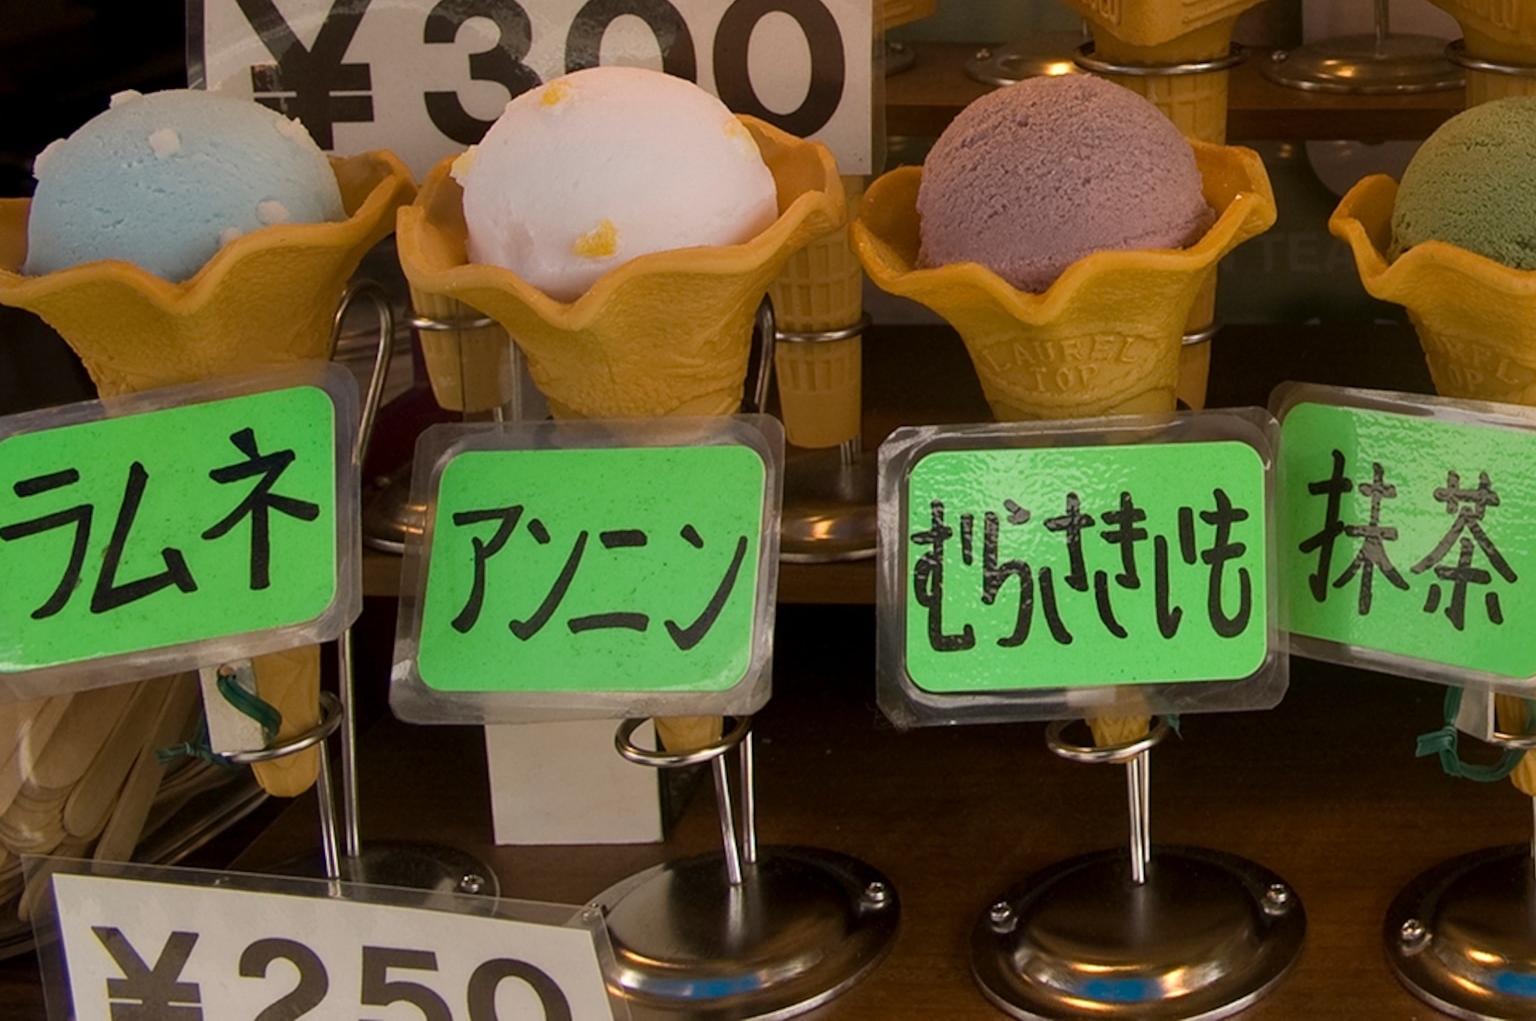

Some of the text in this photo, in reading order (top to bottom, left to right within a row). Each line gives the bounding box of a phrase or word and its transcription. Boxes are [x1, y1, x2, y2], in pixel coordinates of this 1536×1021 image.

[982, 331, 1140, 372] LAUREL
[1029, 364, 1100, 392] TOP
[0, 427, 320, 619] ラムネ
[451, 504, 748, 651] アンニン
[911, 487, 1252, 652] むらさきいも
[1299, 449, 1518, 630] 抹茶
[90, 925, 572, 1021] ¥250
